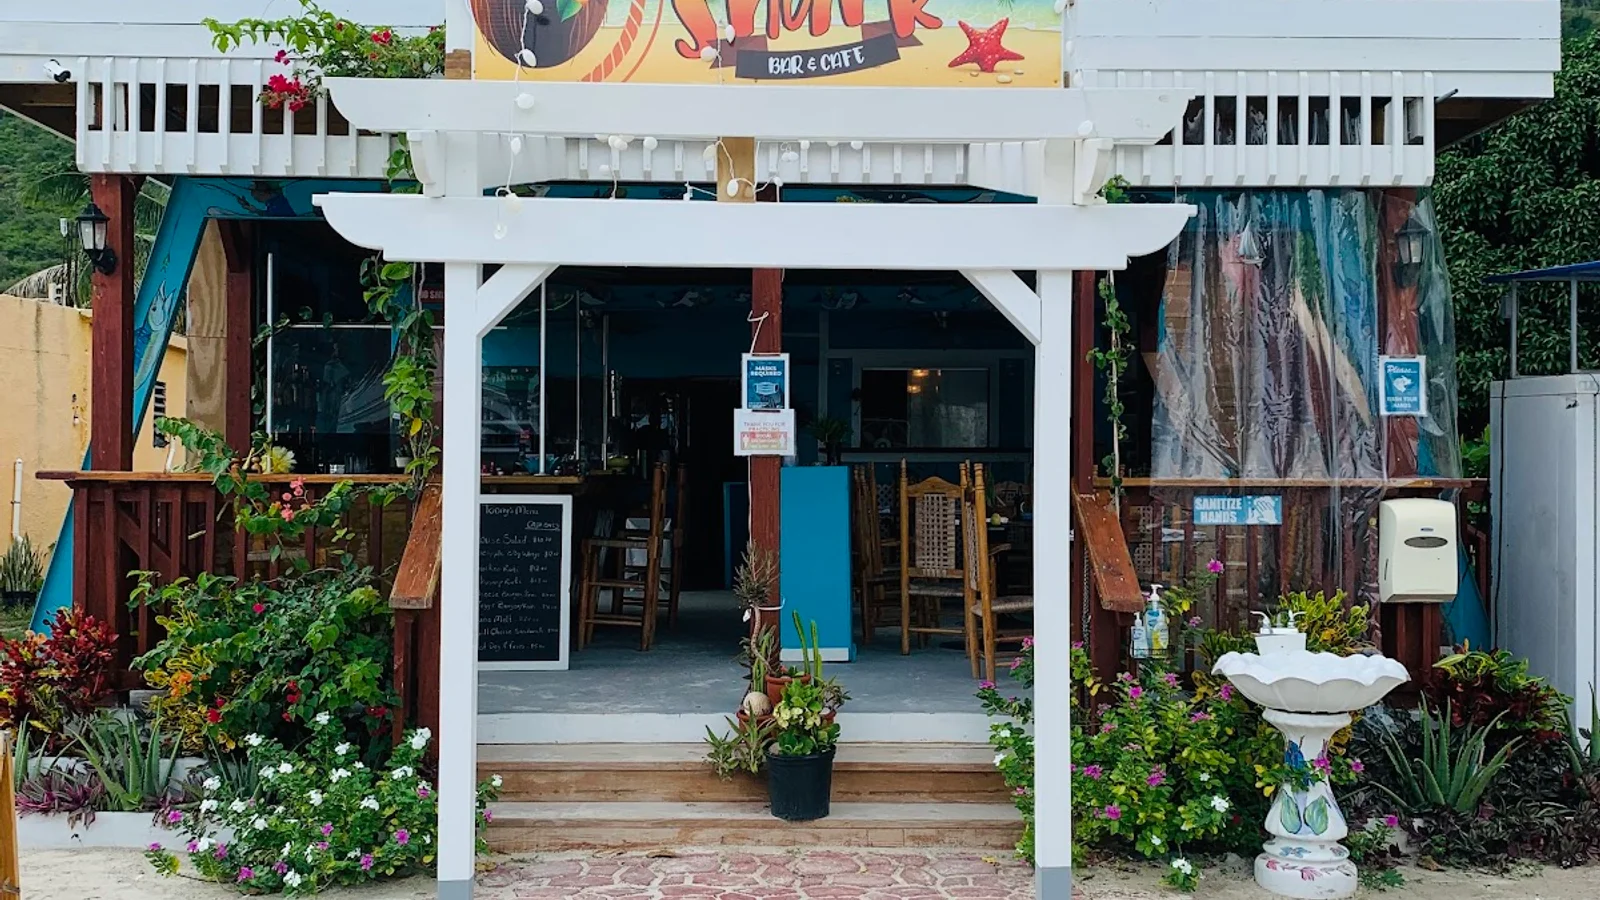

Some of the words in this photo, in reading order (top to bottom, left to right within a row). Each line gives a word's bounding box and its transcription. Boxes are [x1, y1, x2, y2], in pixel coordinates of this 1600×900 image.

[768, 54, 804, 74] BAR
[807, 57, 817, 71] &
[820, 45, 865, 71] CAFE
[1195, 498, 1242, 510] SANITIZE
[1200, 511, 1237, 523] HANDS
[480, 536, 501, 544] ouse
[503, 533, 527, 545] Salad
